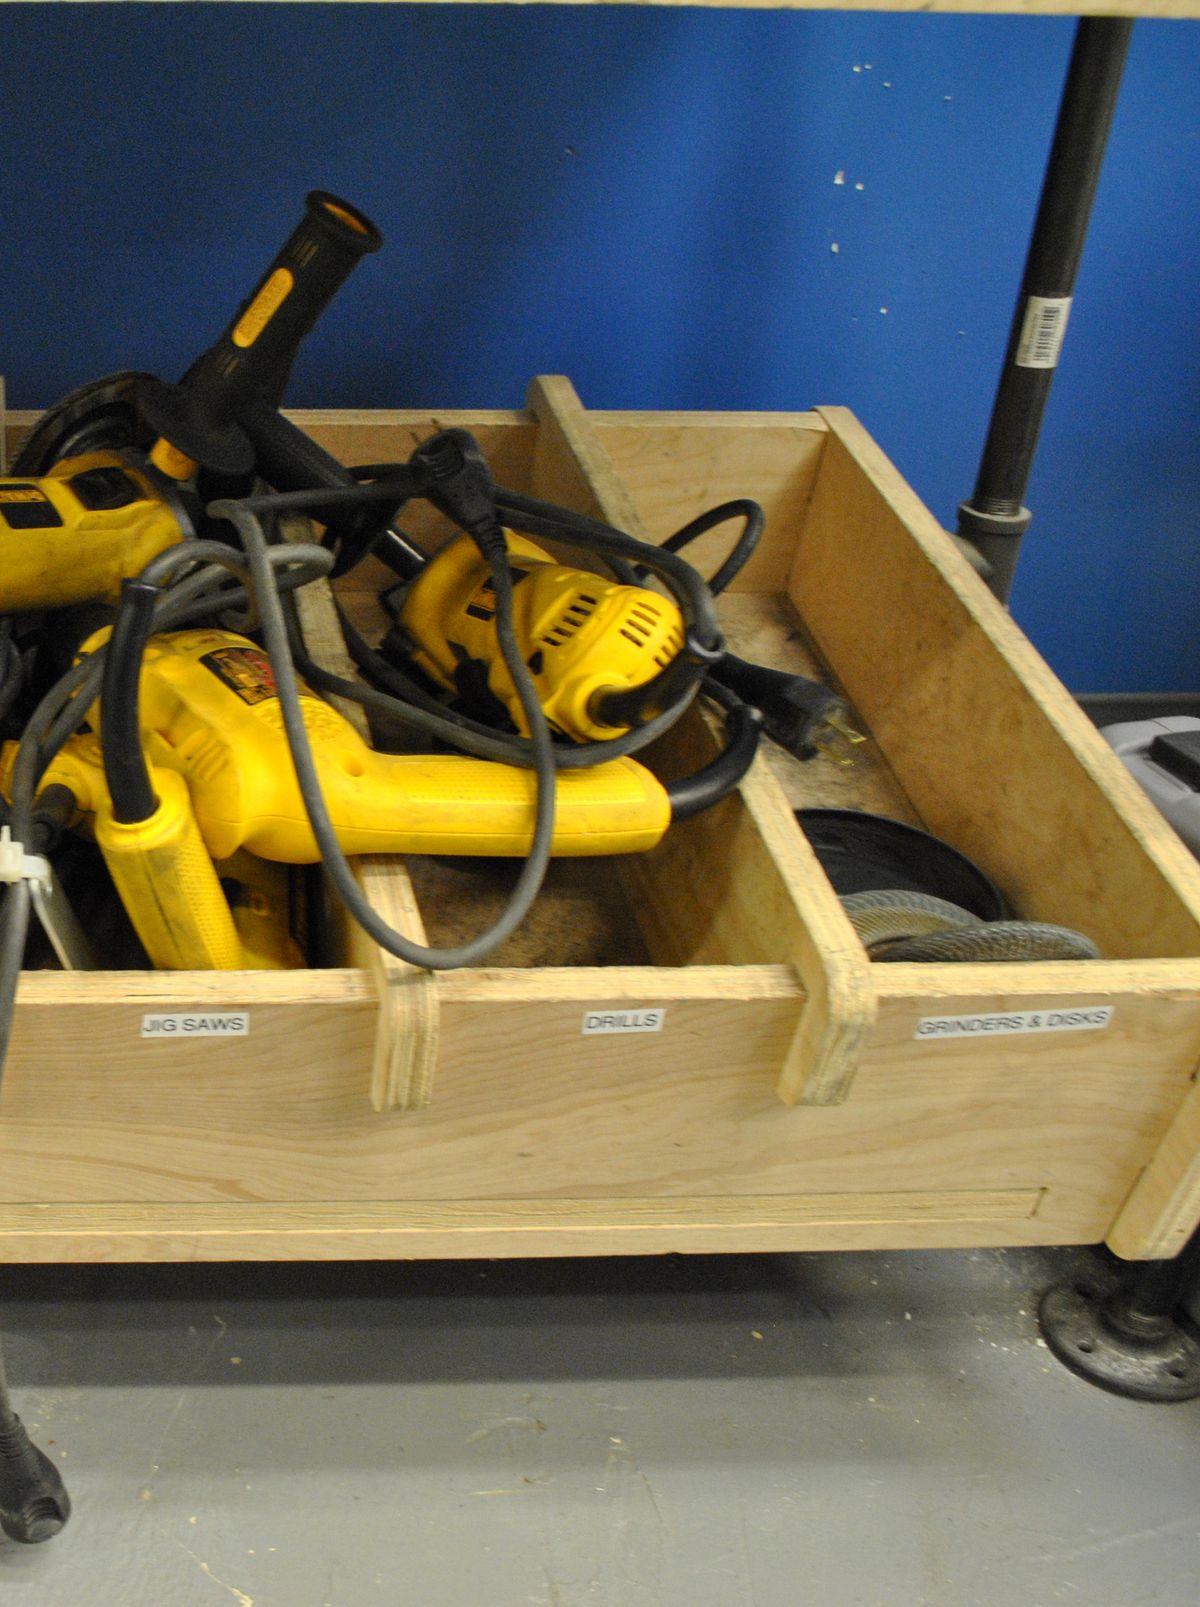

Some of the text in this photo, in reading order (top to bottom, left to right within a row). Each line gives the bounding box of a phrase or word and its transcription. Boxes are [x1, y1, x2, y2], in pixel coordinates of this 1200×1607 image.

[143, 1017, 245, 1032] JIG SAWS
[585, 1013, 659, 1029] DRILLS
[917, 1010, 1109, 1035] GRINDERS & DISKS
